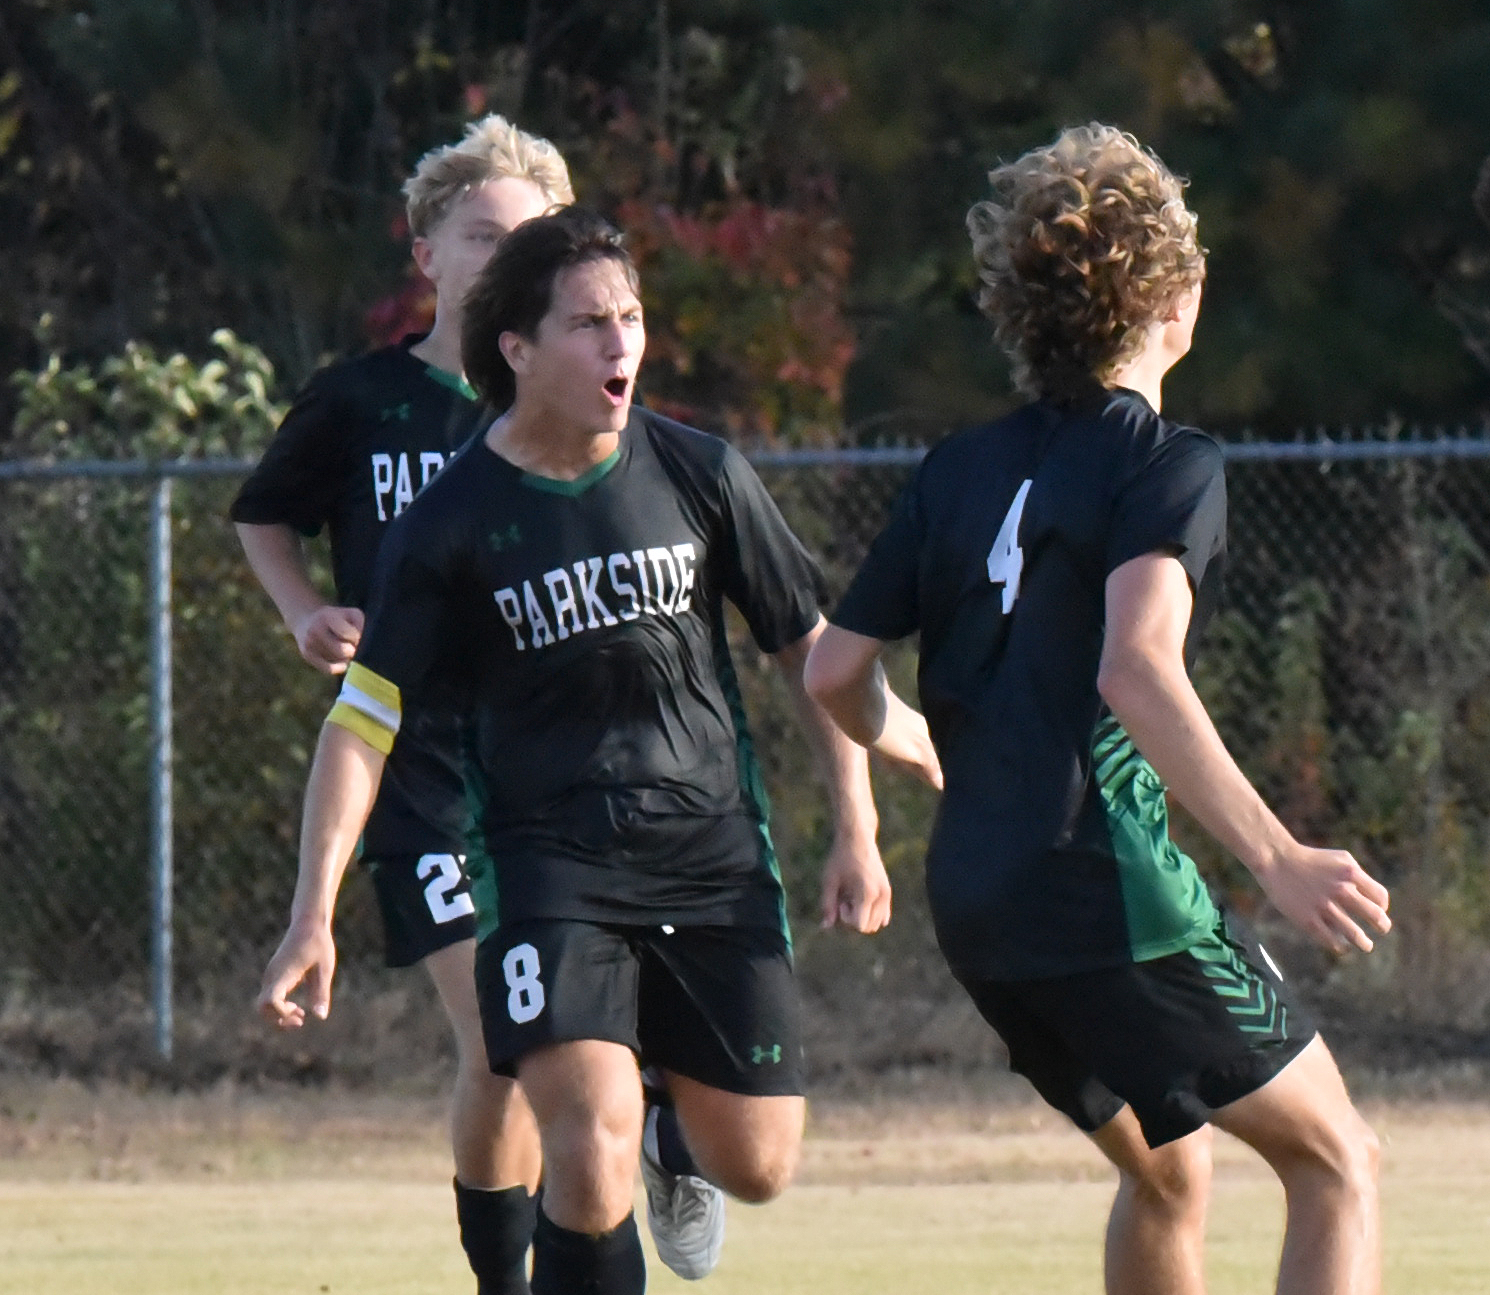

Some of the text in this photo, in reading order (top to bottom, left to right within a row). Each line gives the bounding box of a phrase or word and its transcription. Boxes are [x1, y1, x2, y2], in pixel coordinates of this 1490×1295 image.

[986, 479, 1032, 615] 4
[493, 543, 697, 651] PARKSIDE
[416, 853, 475, 925] 2
[503, 943, 546, 1025] 8
